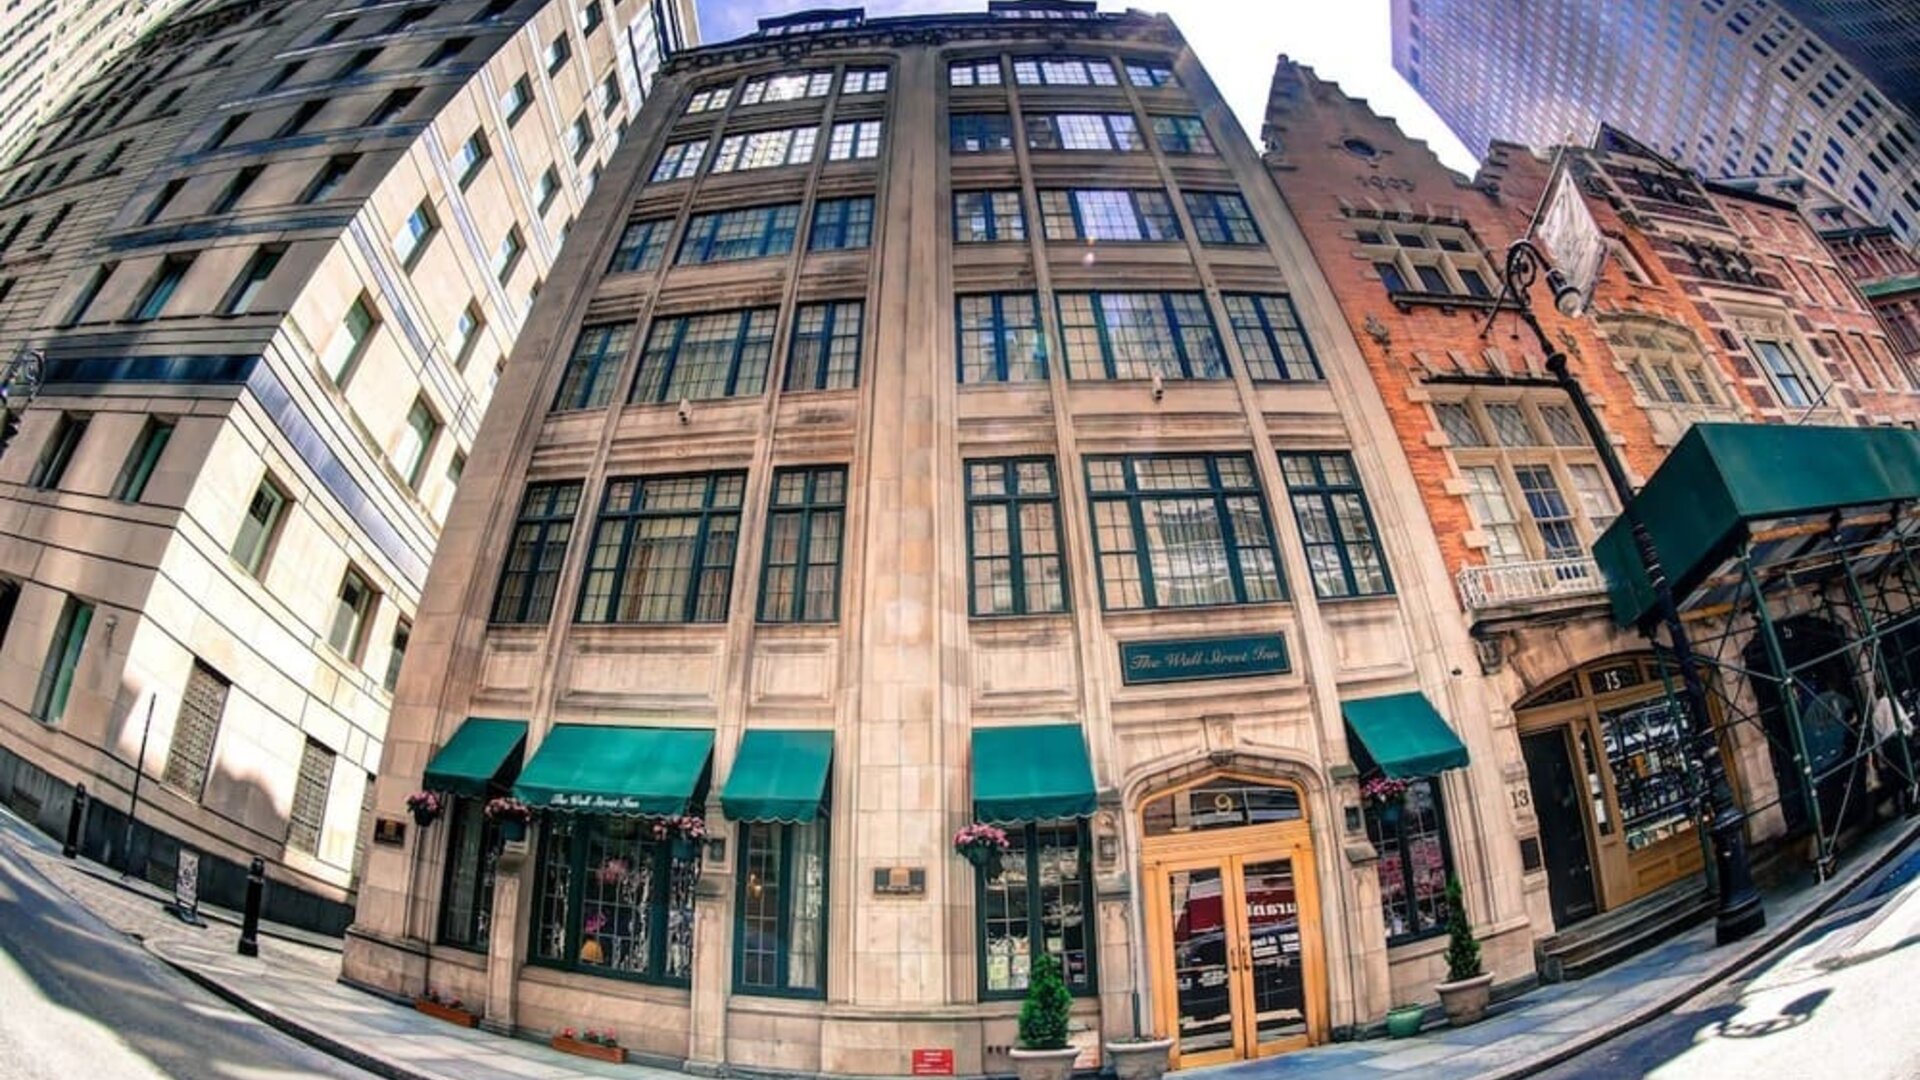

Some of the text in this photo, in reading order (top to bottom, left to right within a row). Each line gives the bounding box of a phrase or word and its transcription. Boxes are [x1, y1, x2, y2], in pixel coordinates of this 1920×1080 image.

[1129, 646, 1281, 670] The Wall Street Inn
[1604, 670, 1621, 690] 15
[1215, 793, 1233, 816] 9
[1510, 789, 1529, 810] 13
